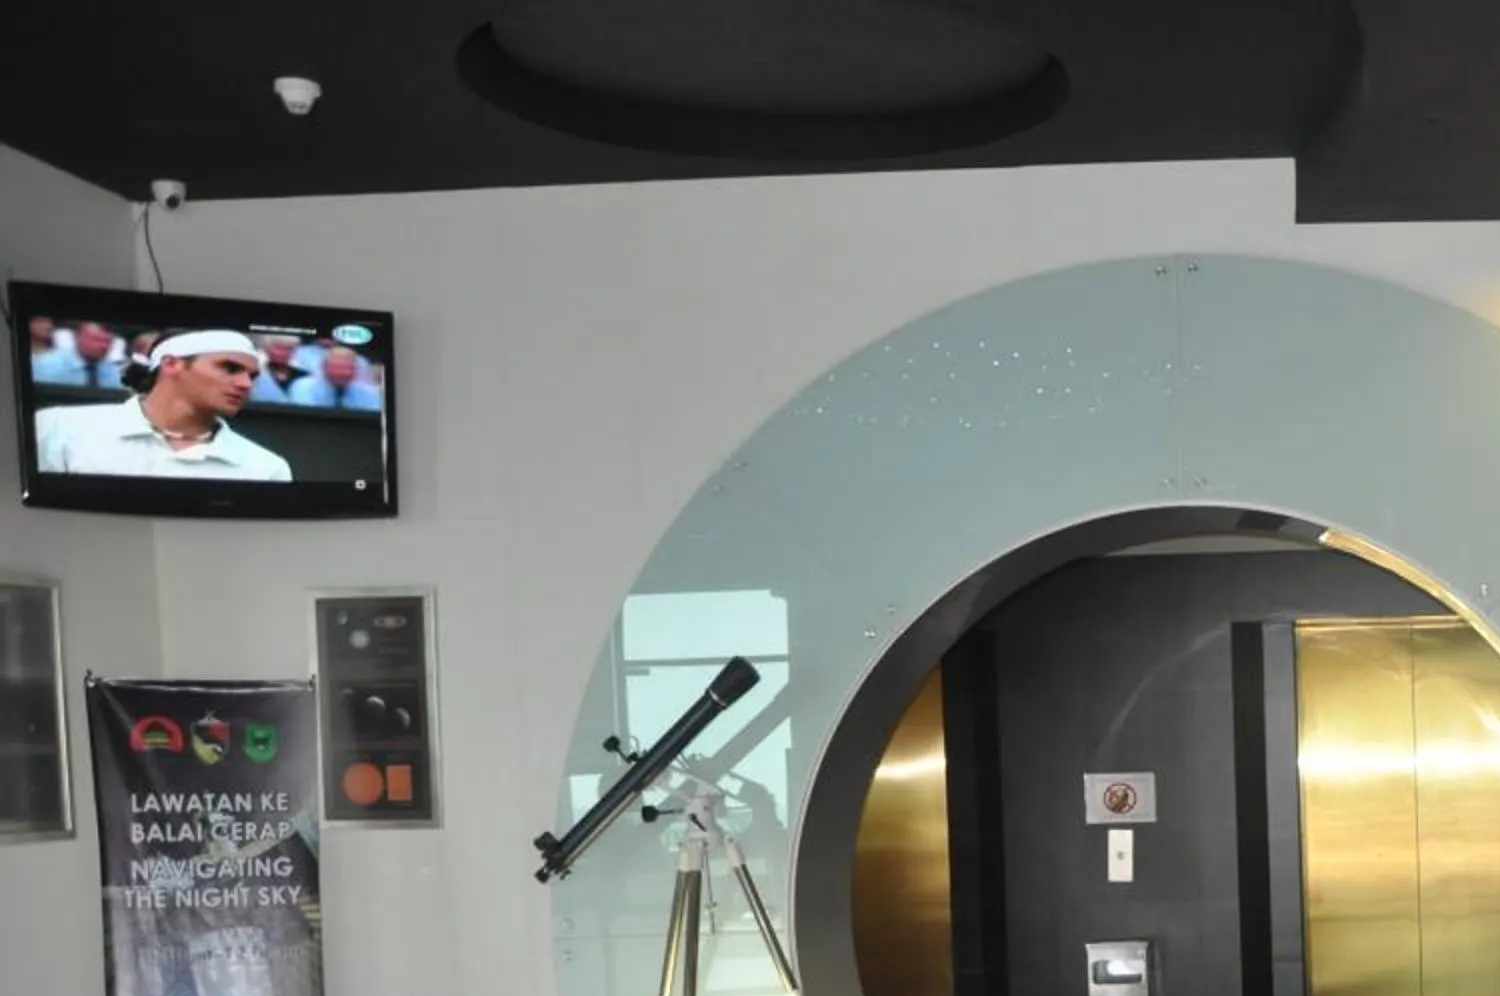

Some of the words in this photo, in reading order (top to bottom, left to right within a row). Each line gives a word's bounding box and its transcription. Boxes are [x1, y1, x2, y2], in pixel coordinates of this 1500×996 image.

[130, 792, 253, 813] LAWATAN
[260, 792, 289, 812] KE
[130, 821, 202, 844] BALAI
[211, 821, 292, 842] CERAP
[130, 856, 294, 884] NAVIGATING
[125, 886, 168, 909] THE
[175, 887, 251, 908] NIGHT
[257, 885, 302, 906] SKY
